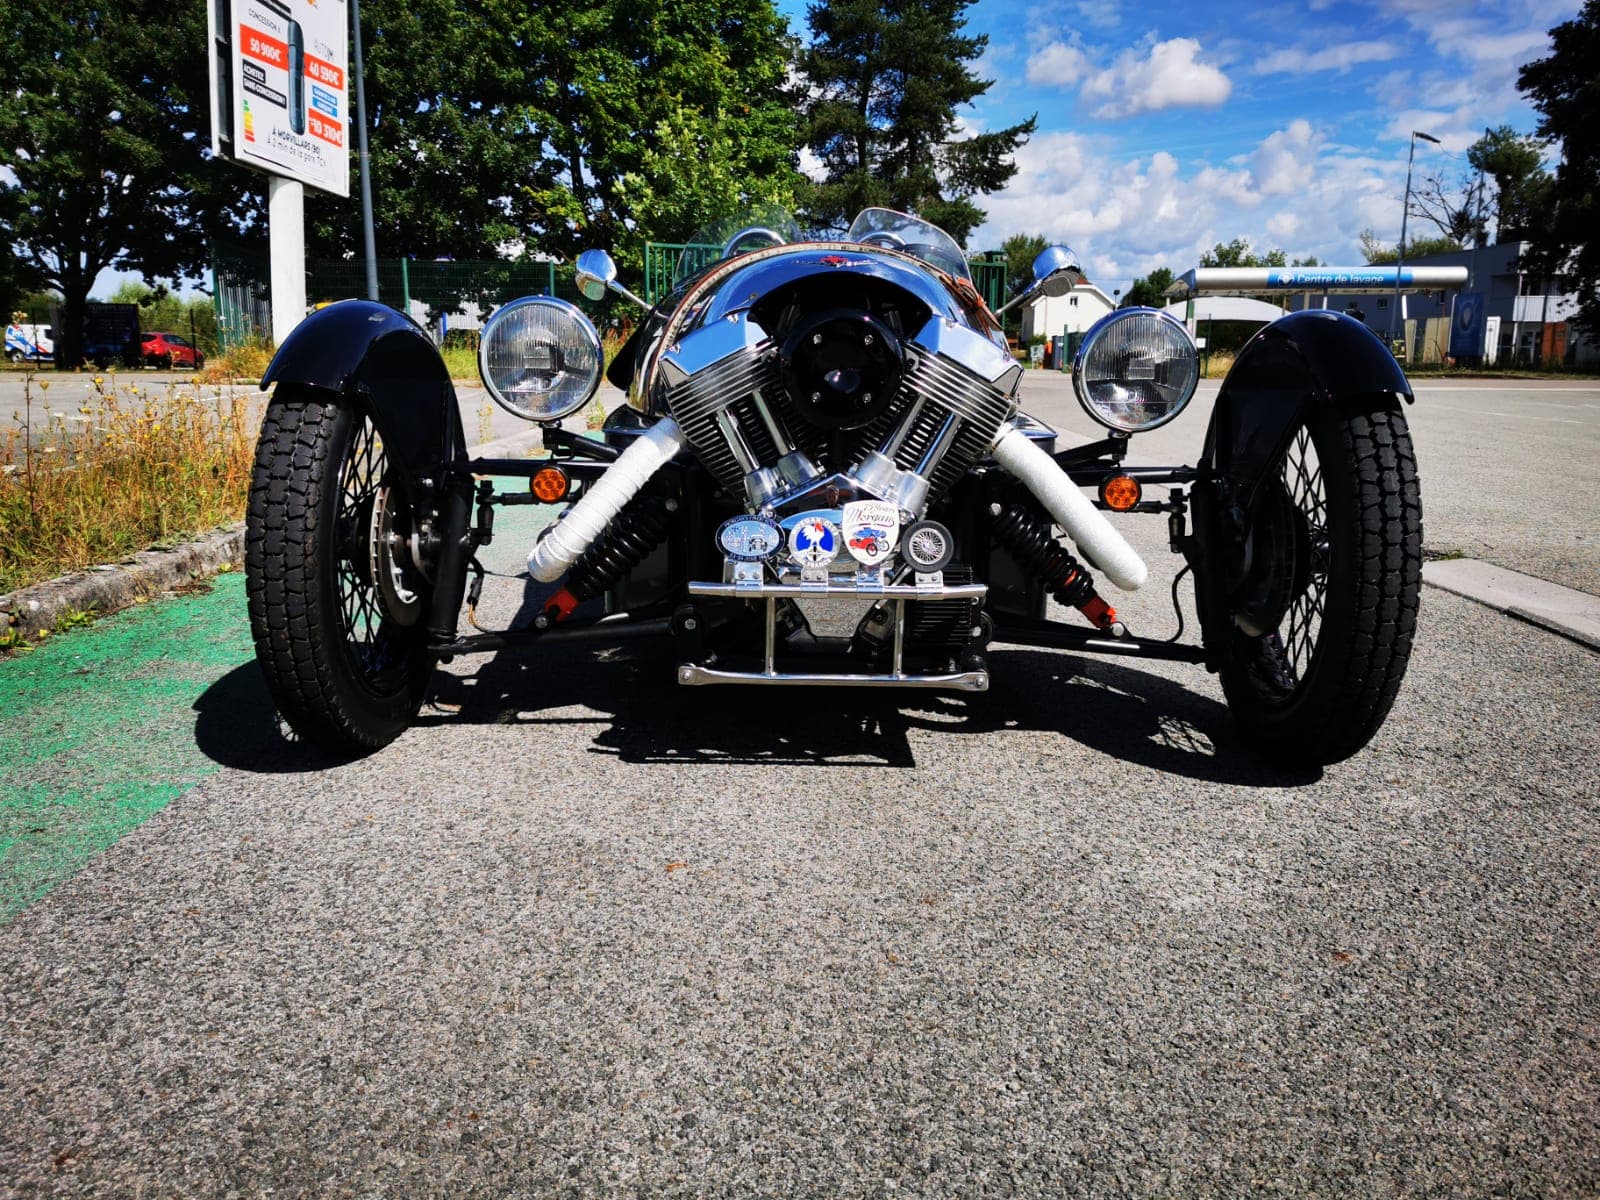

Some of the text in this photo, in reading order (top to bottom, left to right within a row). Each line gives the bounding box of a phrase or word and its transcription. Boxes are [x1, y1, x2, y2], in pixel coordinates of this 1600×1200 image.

[1298, 273, 1384, 286] Centre de lavage
